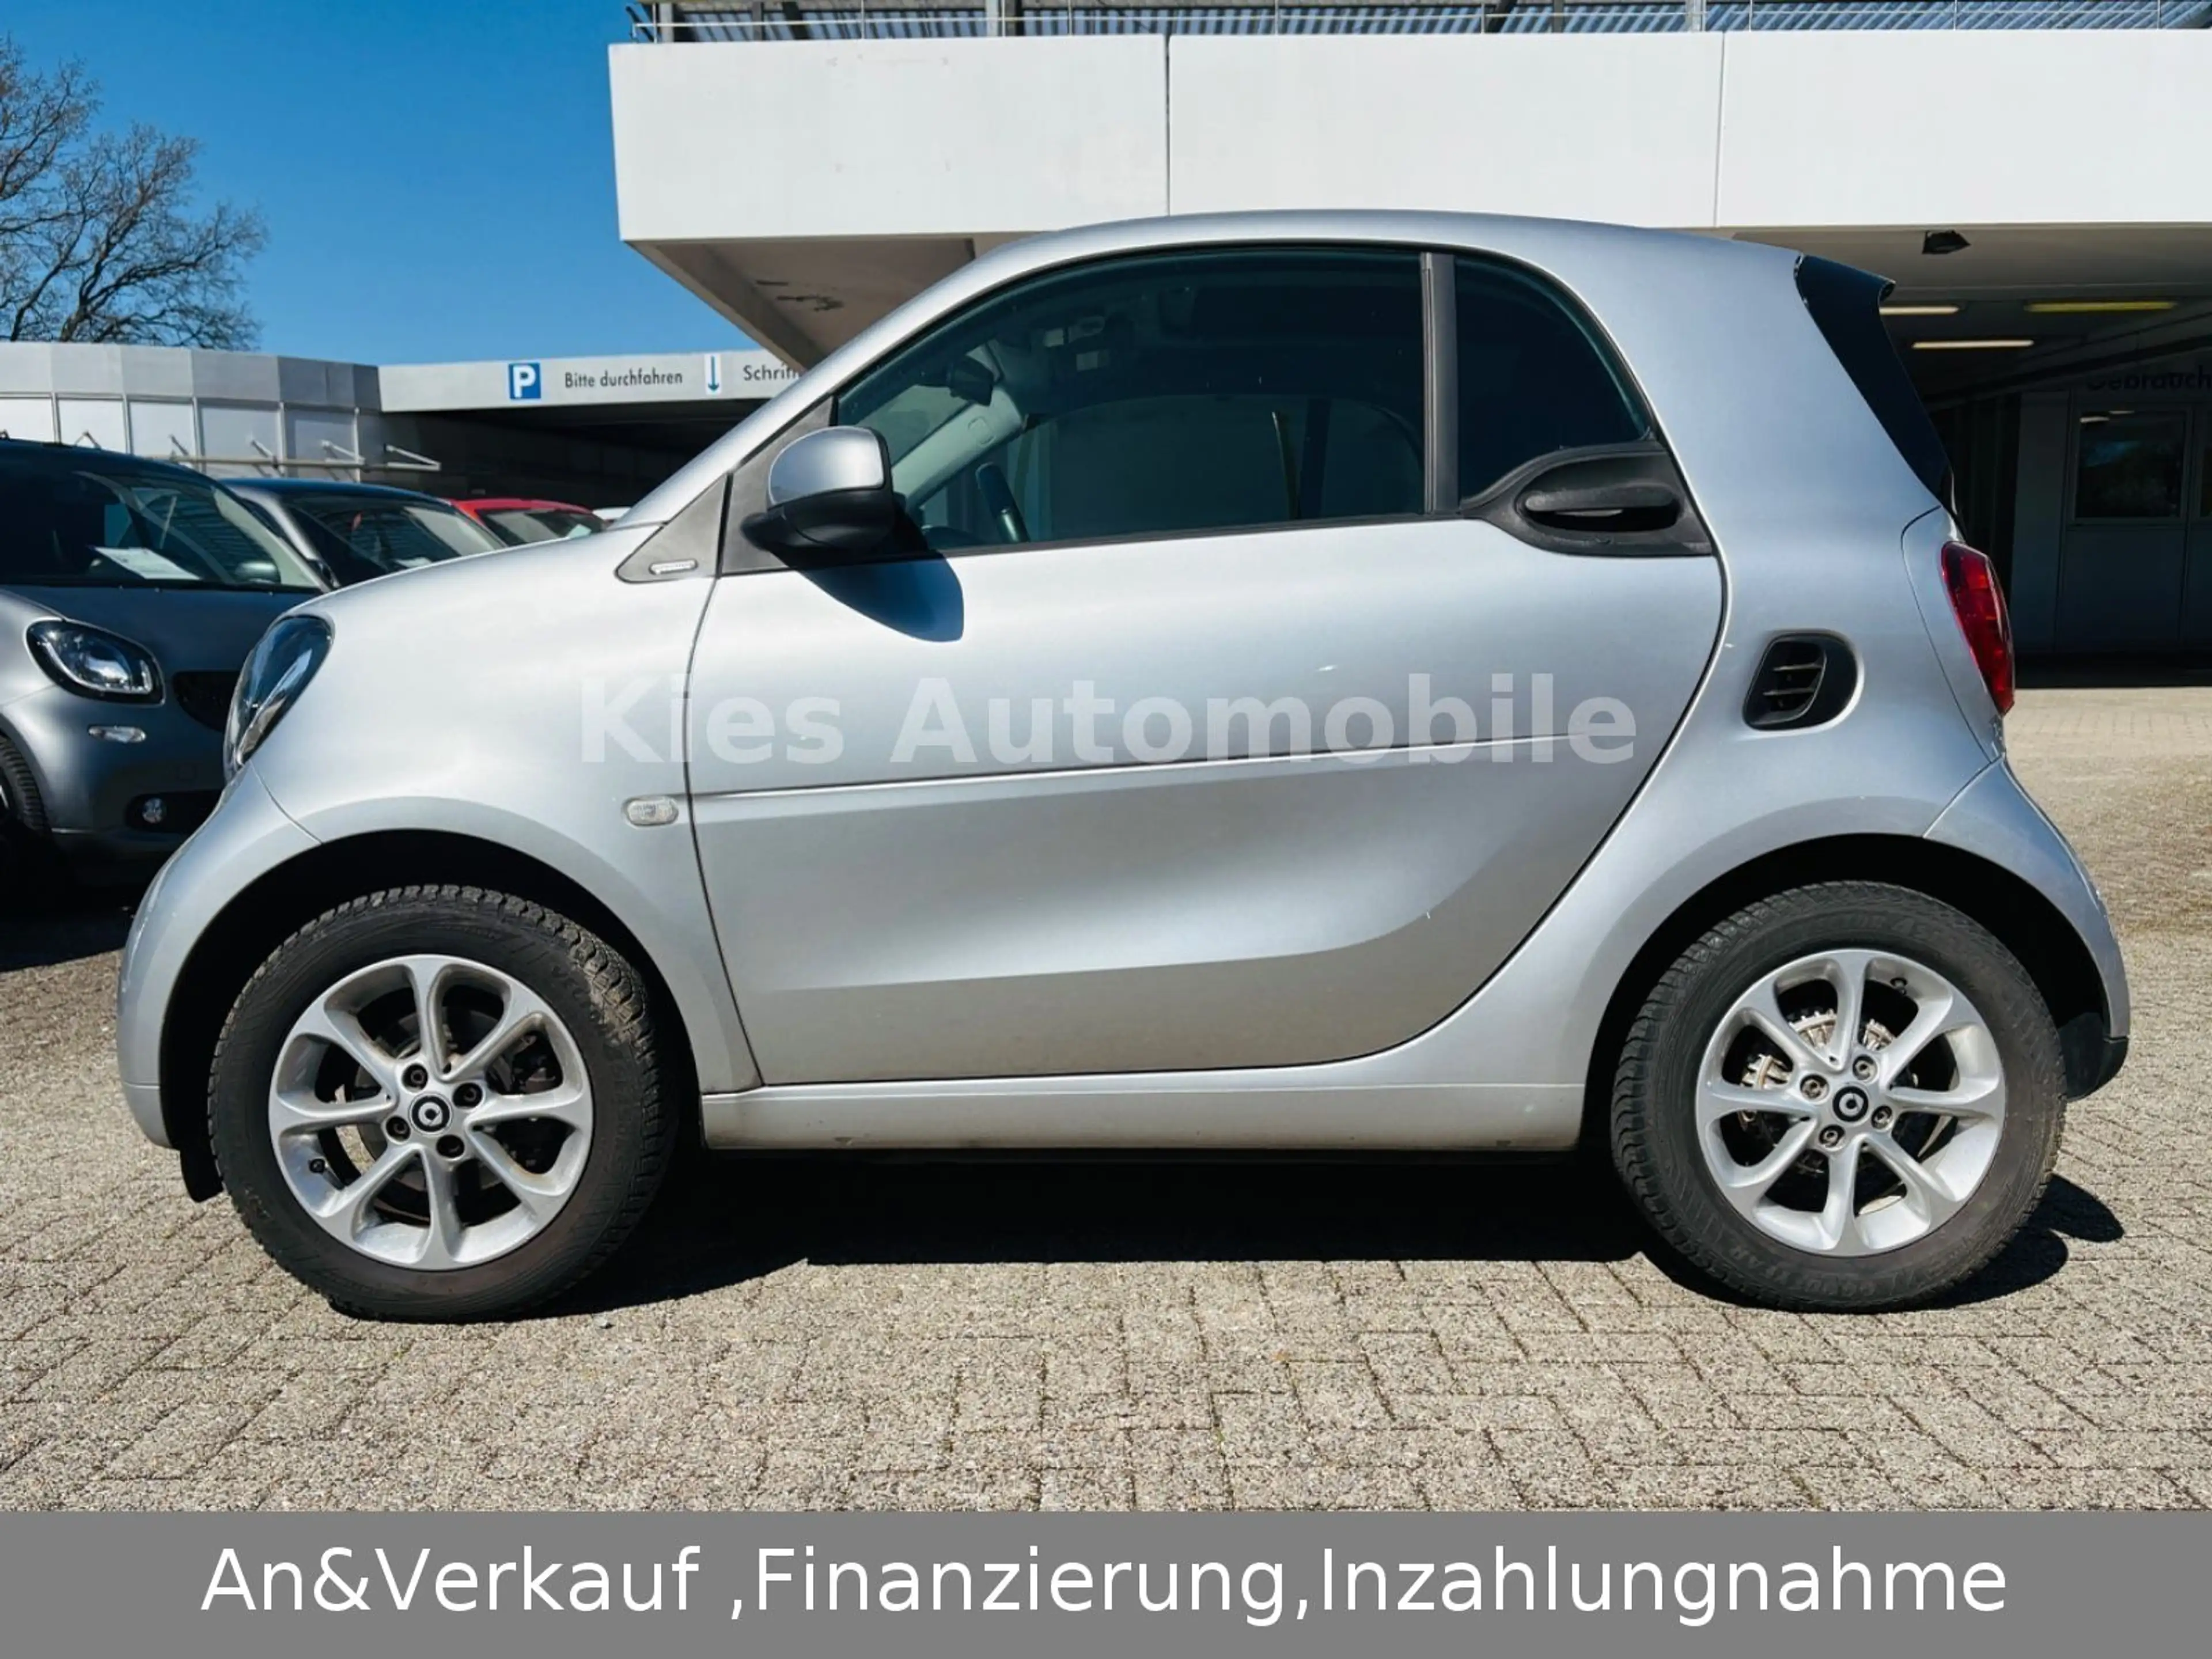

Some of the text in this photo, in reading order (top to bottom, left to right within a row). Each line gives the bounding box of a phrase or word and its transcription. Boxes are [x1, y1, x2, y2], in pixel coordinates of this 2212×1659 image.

[513, 365, 536, 397] P
[565, 368, 683, 388] Bitte durchfahren
